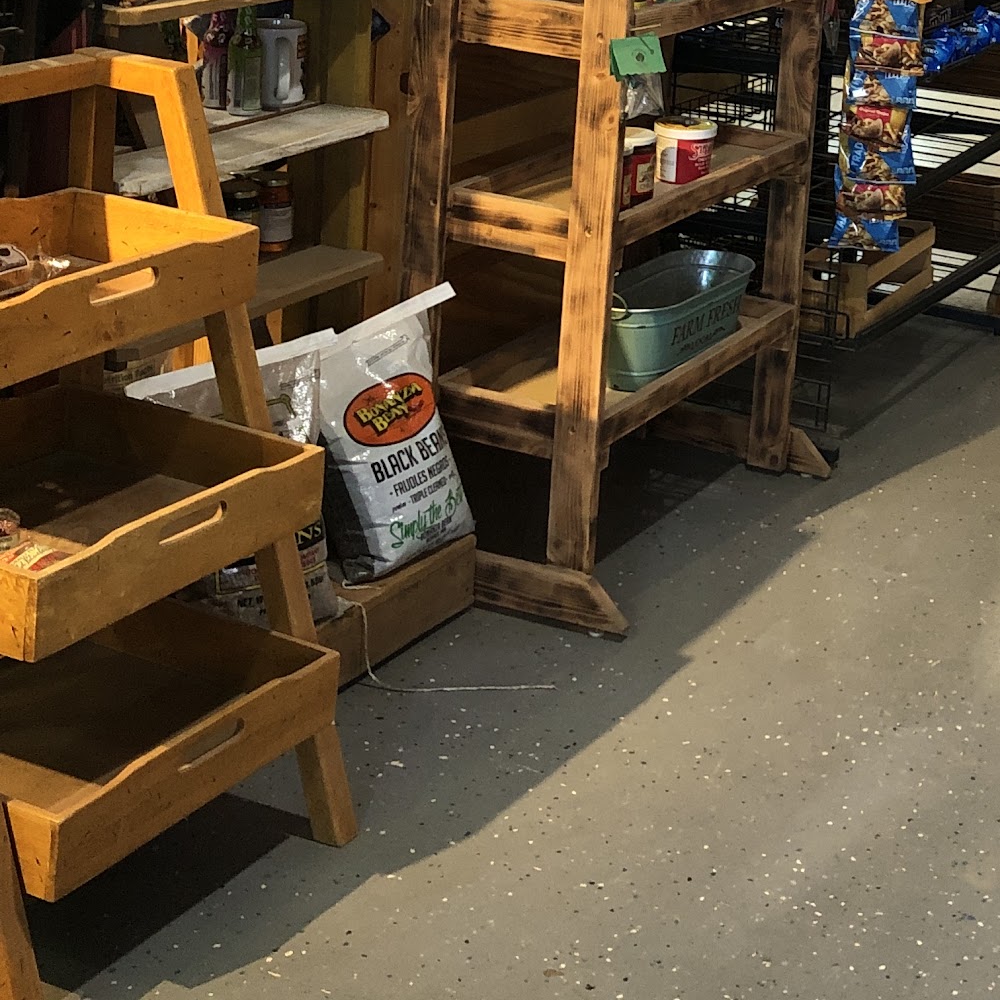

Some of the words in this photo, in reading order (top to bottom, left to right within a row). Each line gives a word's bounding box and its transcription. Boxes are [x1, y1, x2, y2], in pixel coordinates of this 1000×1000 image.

[355, 382, 423, 424] BONANZA
[370, 441, 419, 484] BLACK
[389, 512, 428, 549] Simply
[427, 499, 443, 523] the
